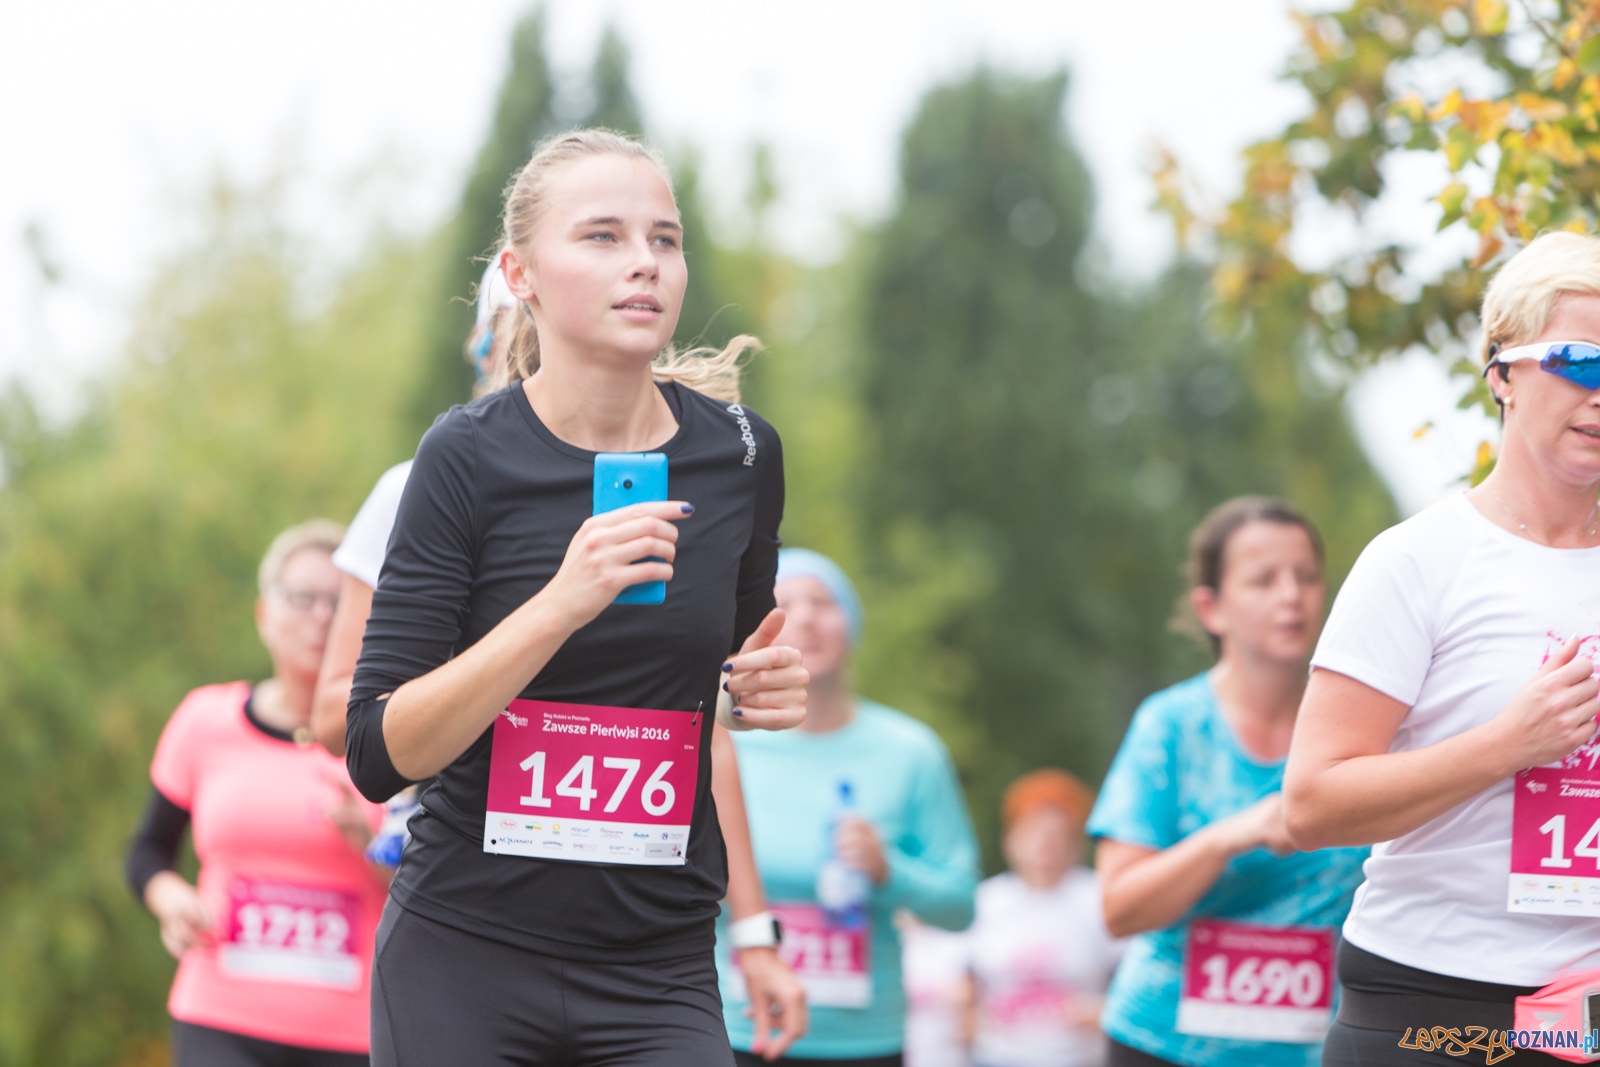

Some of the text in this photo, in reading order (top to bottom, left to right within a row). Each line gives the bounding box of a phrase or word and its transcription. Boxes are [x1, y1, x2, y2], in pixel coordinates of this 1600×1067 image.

[736, 416, 757, 467] Reebok
[542, 719, 587, 735] Zawsze
[590, 722, 639, 740] Pier(w)si
[641, 727, 670, 741] 2016
[519, 751, 676, 817] 1476
[237, 903, 350, 957] 1712
[779, 930, 847, 979] 711
[1201, 953, 1324, 1007] 1690
